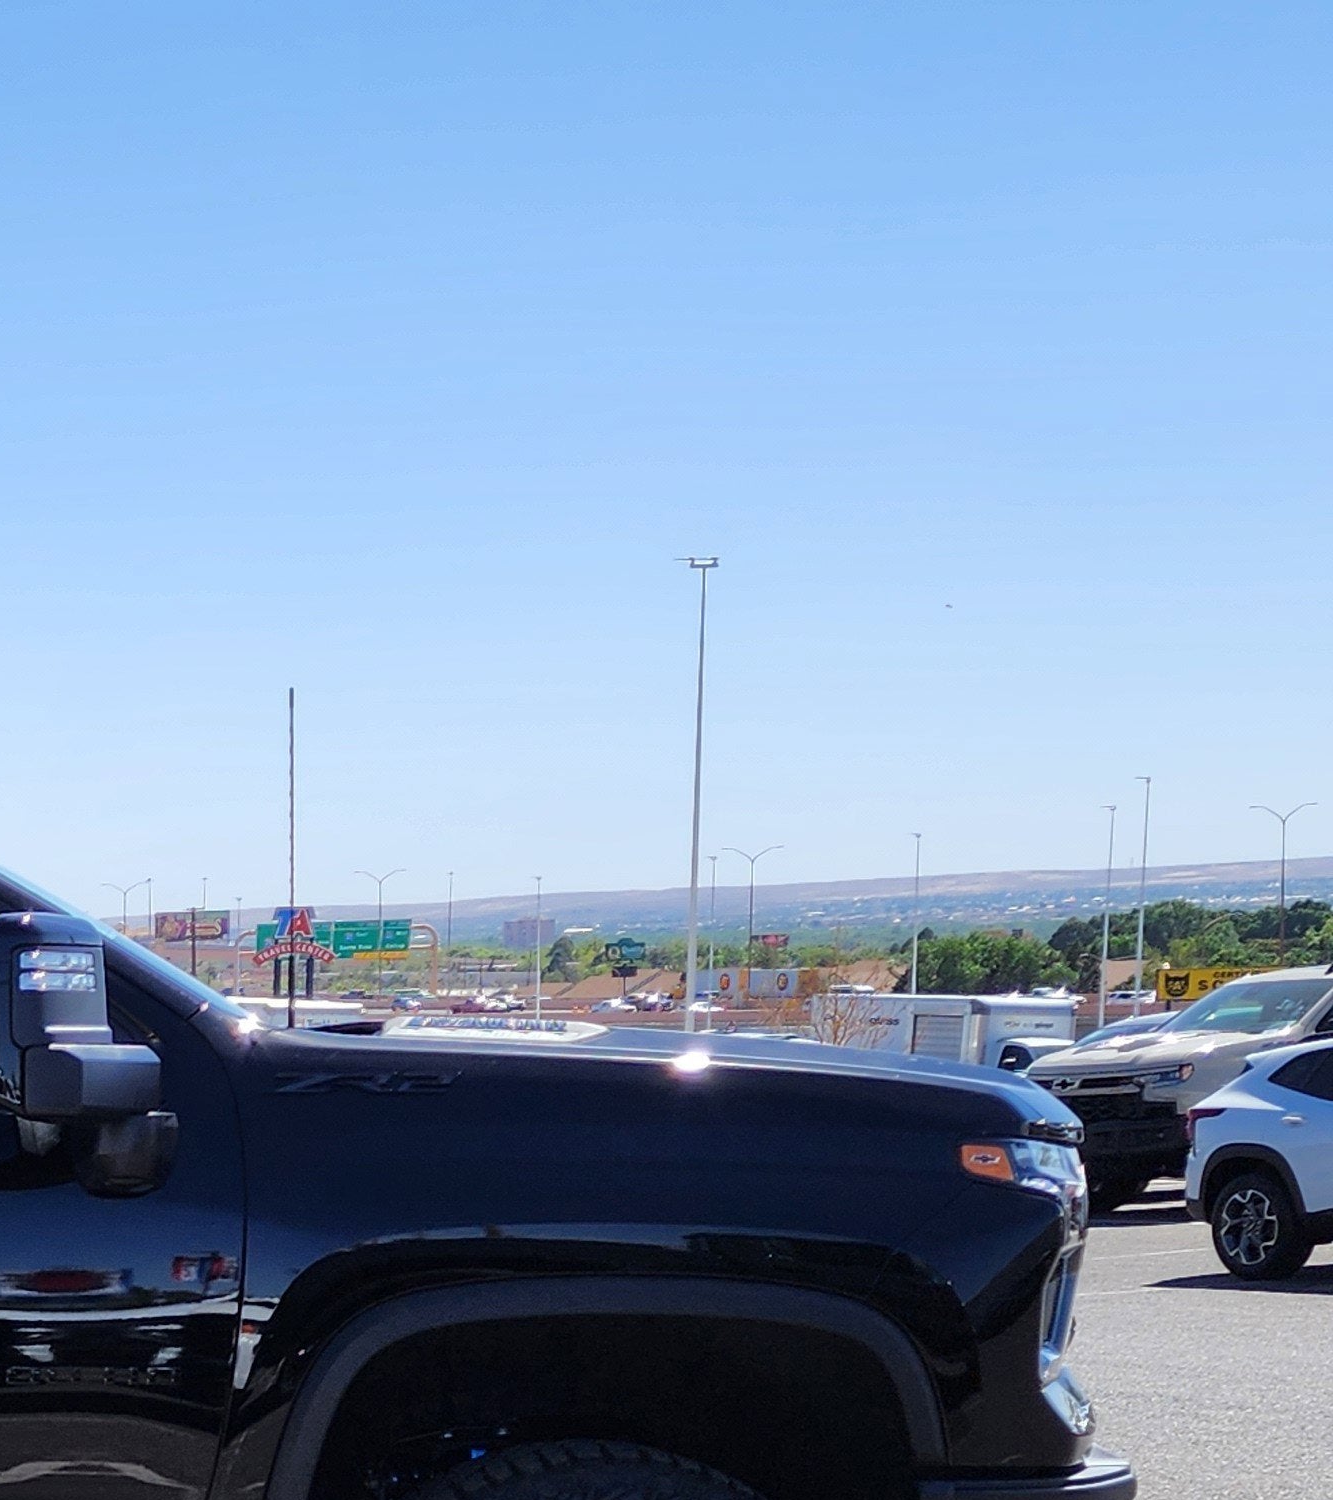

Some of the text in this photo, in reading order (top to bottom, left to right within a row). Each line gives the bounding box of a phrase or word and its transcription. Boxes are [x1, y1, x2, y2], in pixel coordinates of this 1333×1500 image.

[274, 907, 313, 938] TA
[258, 944, 331, 961] TRAVEL CENTER
